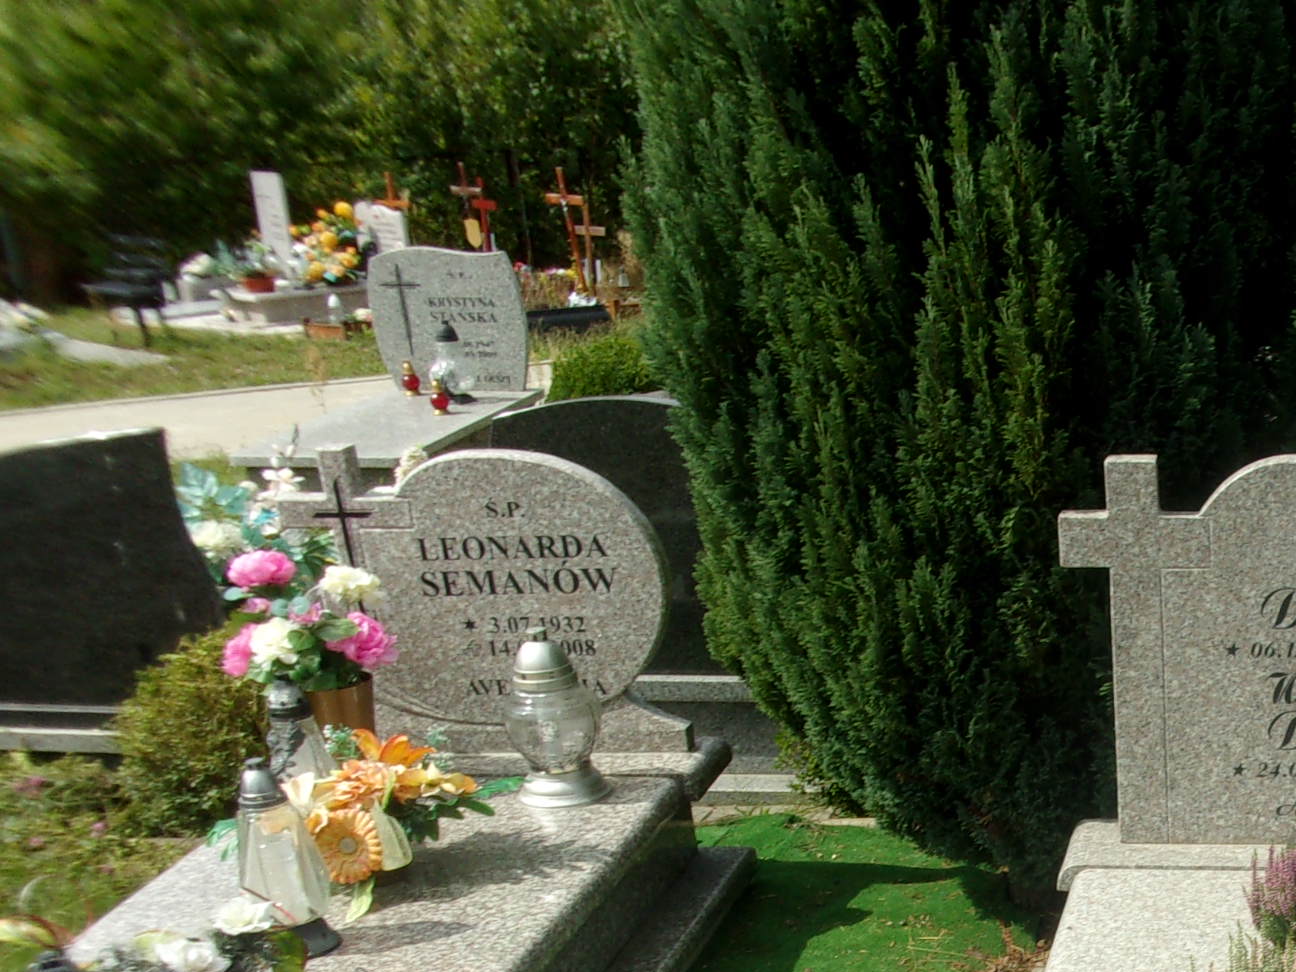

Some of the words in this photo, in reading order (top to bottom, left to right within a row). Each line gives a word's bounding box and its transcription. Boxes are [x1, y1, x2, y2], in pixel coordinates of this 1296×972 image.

[417, 533, 609, 563] LEONARDA
[421, 561, 618, 598] SEMANÓW
[488, 615, 587, 634] 3.071932
